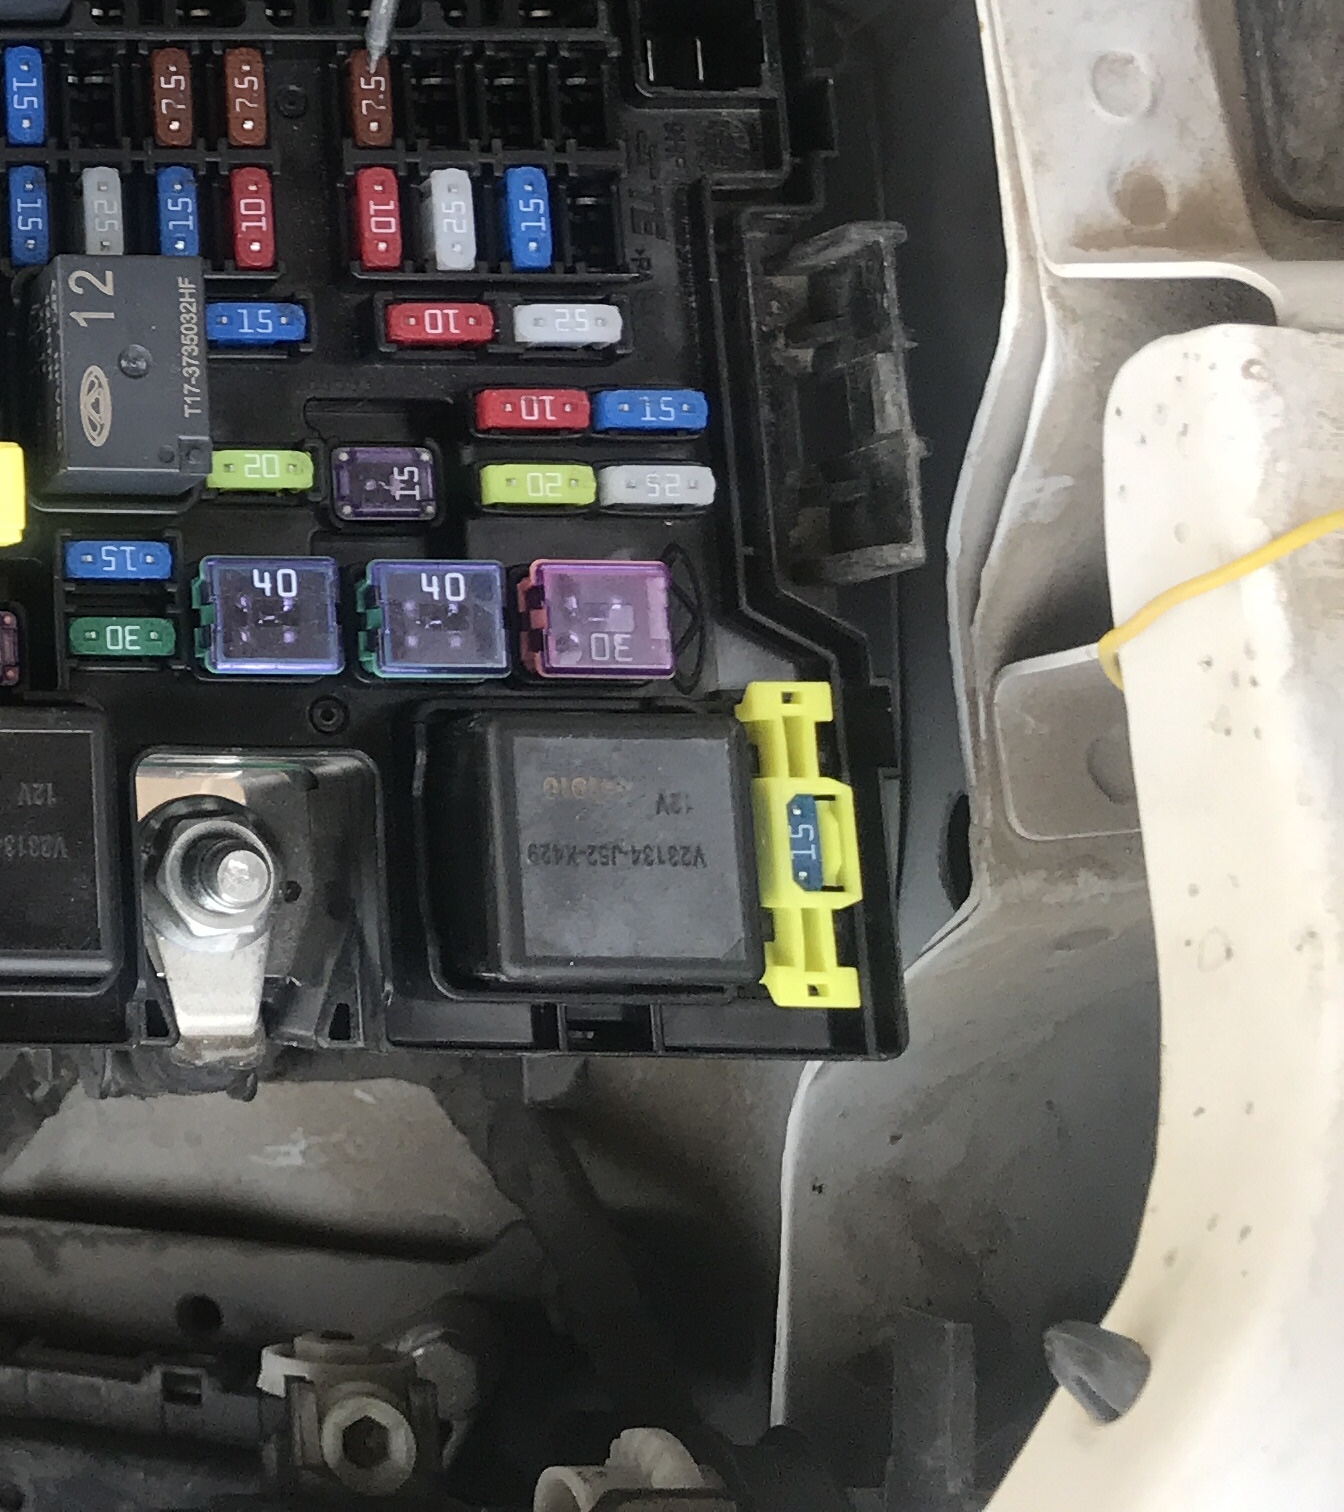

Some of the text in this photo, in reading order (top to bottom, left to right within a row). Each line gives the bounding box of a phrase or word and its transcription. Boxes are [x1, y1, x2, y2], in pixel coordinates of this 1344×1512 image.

[12, 77, 39, 110] 15
[159, 74, 186, 114] 7.5
[234, 75, 259, 113] 7.5
[360, 76, 387, 116] 7.5
[16, 198, 43, 231] 15
[93, 199, 119, 232] 25
[168, 196, 194, 231] 15
[239, 197, 267, 232] 10
[369, 200, 396, 234] 10
[441, 200, 468, 234] 25
[518, 197, 546, 232] 15
[68, 269, 115, 328] 12
[237, 308, 273, 334] 15
[424, 308, 459, 335] 10
[554, 308, 587, 331] 25
[176, 277, 203, 419] T17-3735032HF
[519, 394, 558, 422] 10
[640, 396, 675, 422] 15
[243, 454, 279, 478] 20
[394, 466, 420, 501] 15
[526, 473, 562, 497] 20
[646, 473, 681, 497] 25
[101, 546, 135, 571] 15
[252, 567, 298, 597] 40
[421, 571, 467, 601] 40
[106, 625, 140, 650] 30
[591, 633, 633, 661] 30
[790, 824, 815, 860] 15
